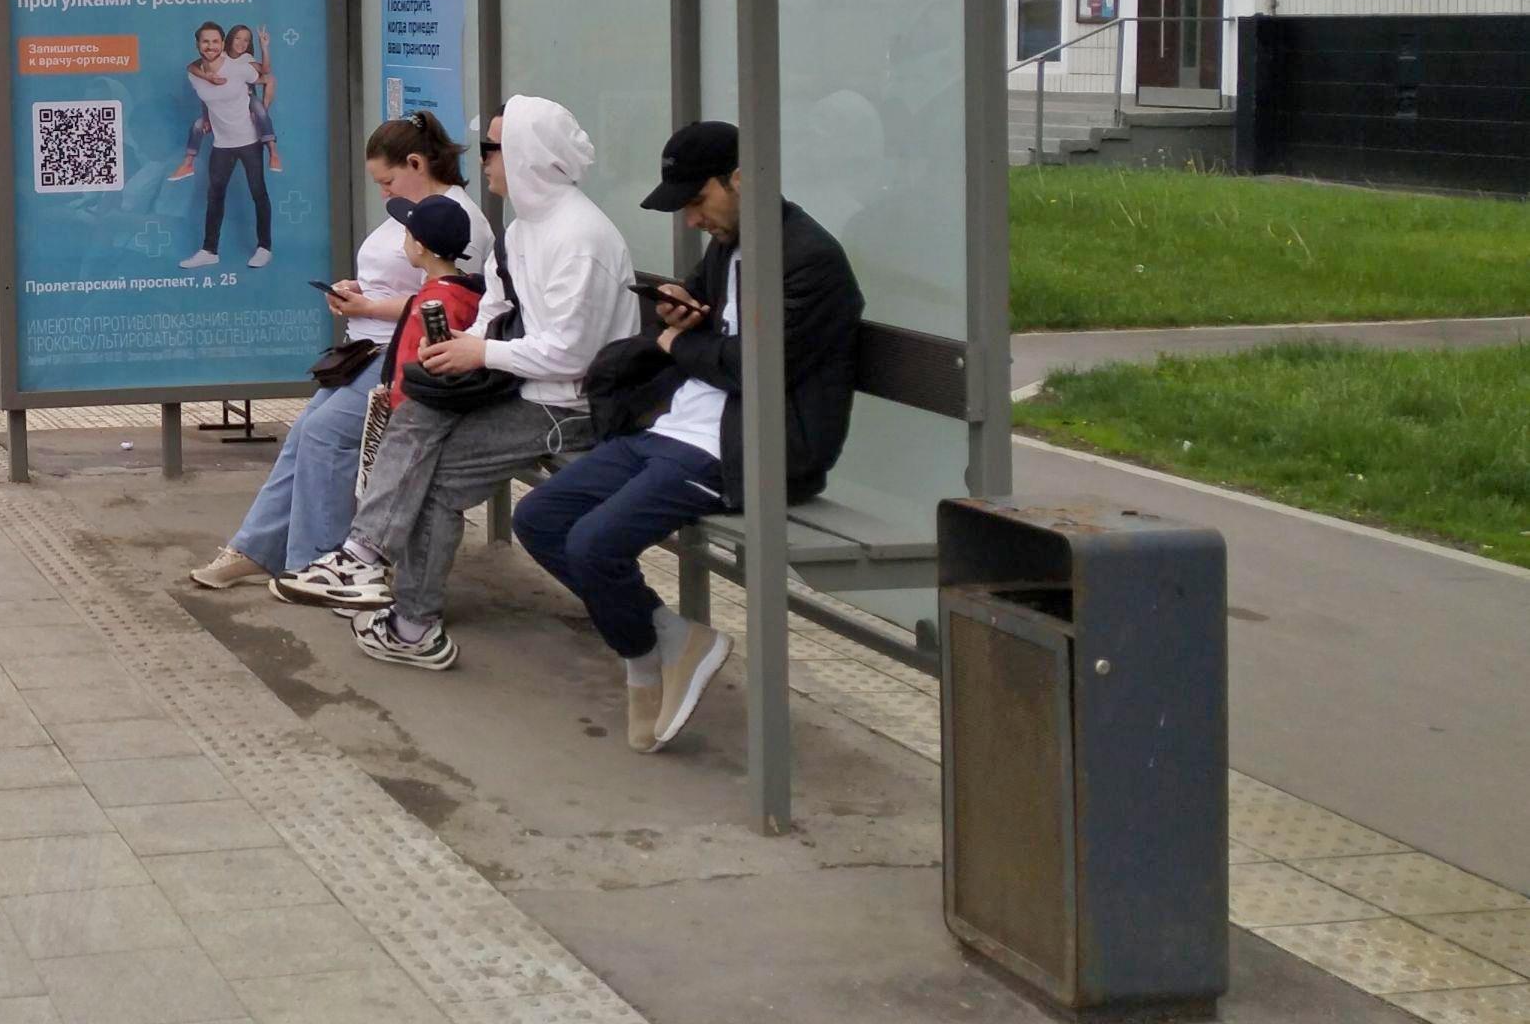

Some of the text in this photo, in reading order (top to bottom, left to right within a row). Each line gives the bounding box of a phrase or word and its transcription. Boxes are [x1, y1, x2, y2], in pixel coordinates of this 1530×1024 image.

[387, 21, 439, 38] когда приедет
[28, 42, 99, 55] Запишитесь
[387, 42, 440, 60] ваш транспорт
[29, 53, 131, 69] к врачу-ортопеду
[25, 273, 237, 295] Пролетарский проспект, д. 25
[27, 317, 91, 335] ИМЕЮТСЯ
[234, 308, 320, 327] НЕОБХОДИМО
[27, 326, 320, 353] ПРОКОНСУЛЬТИРОВАТЬСЯ СО СПЕЦИАЛИСТОМ
